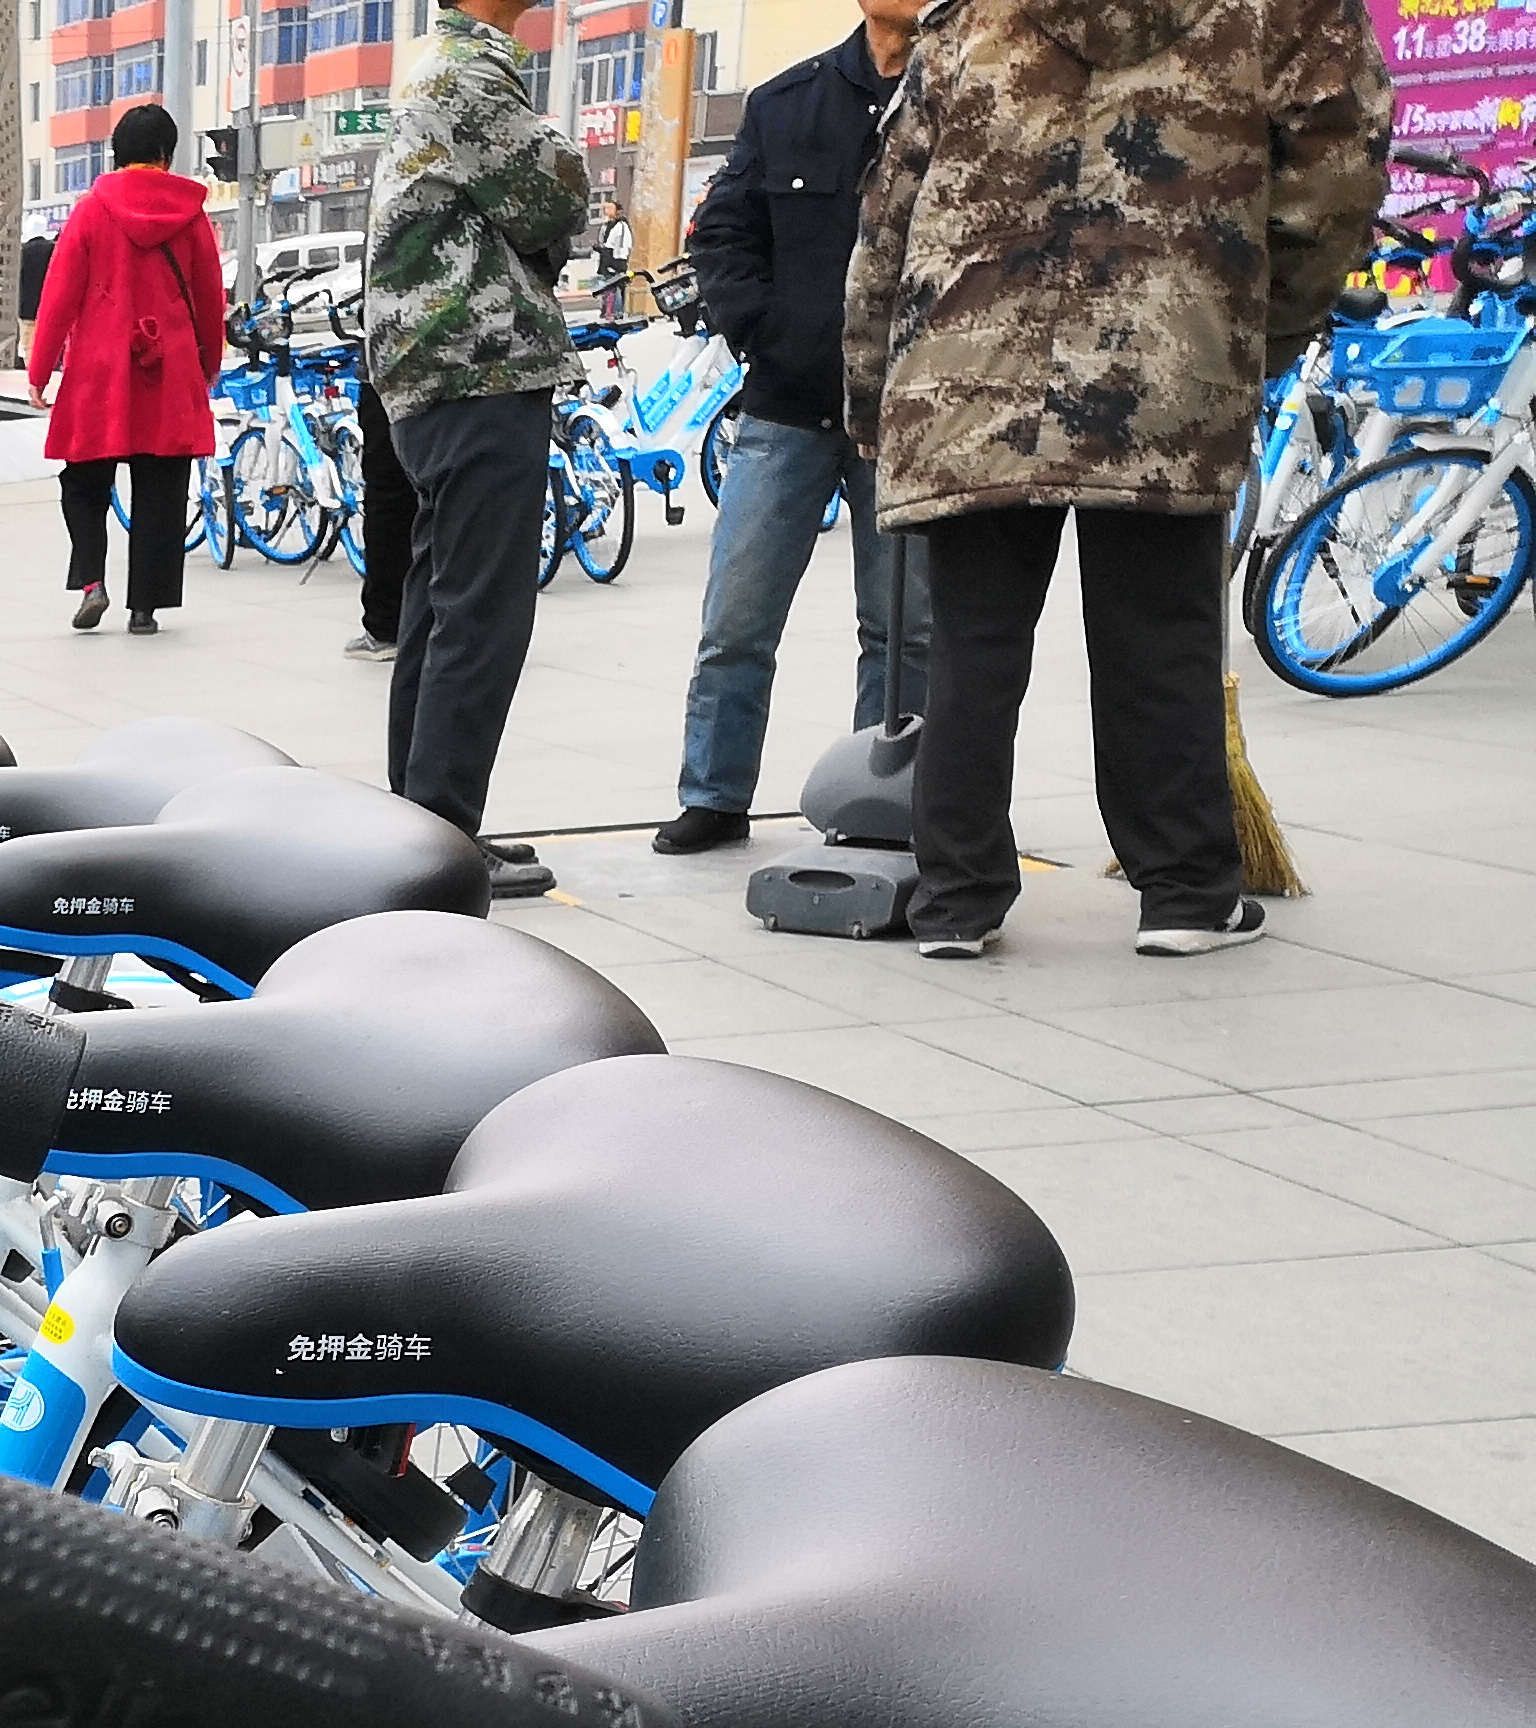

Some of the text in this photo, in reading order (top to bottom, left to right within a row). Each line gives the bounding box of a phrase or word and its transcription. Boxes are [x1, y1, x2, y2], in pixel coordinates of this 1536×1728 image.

[51, 895, 136, 916] 免押金骑车
[286, 1333, 432, 1363] 免押金骑车
